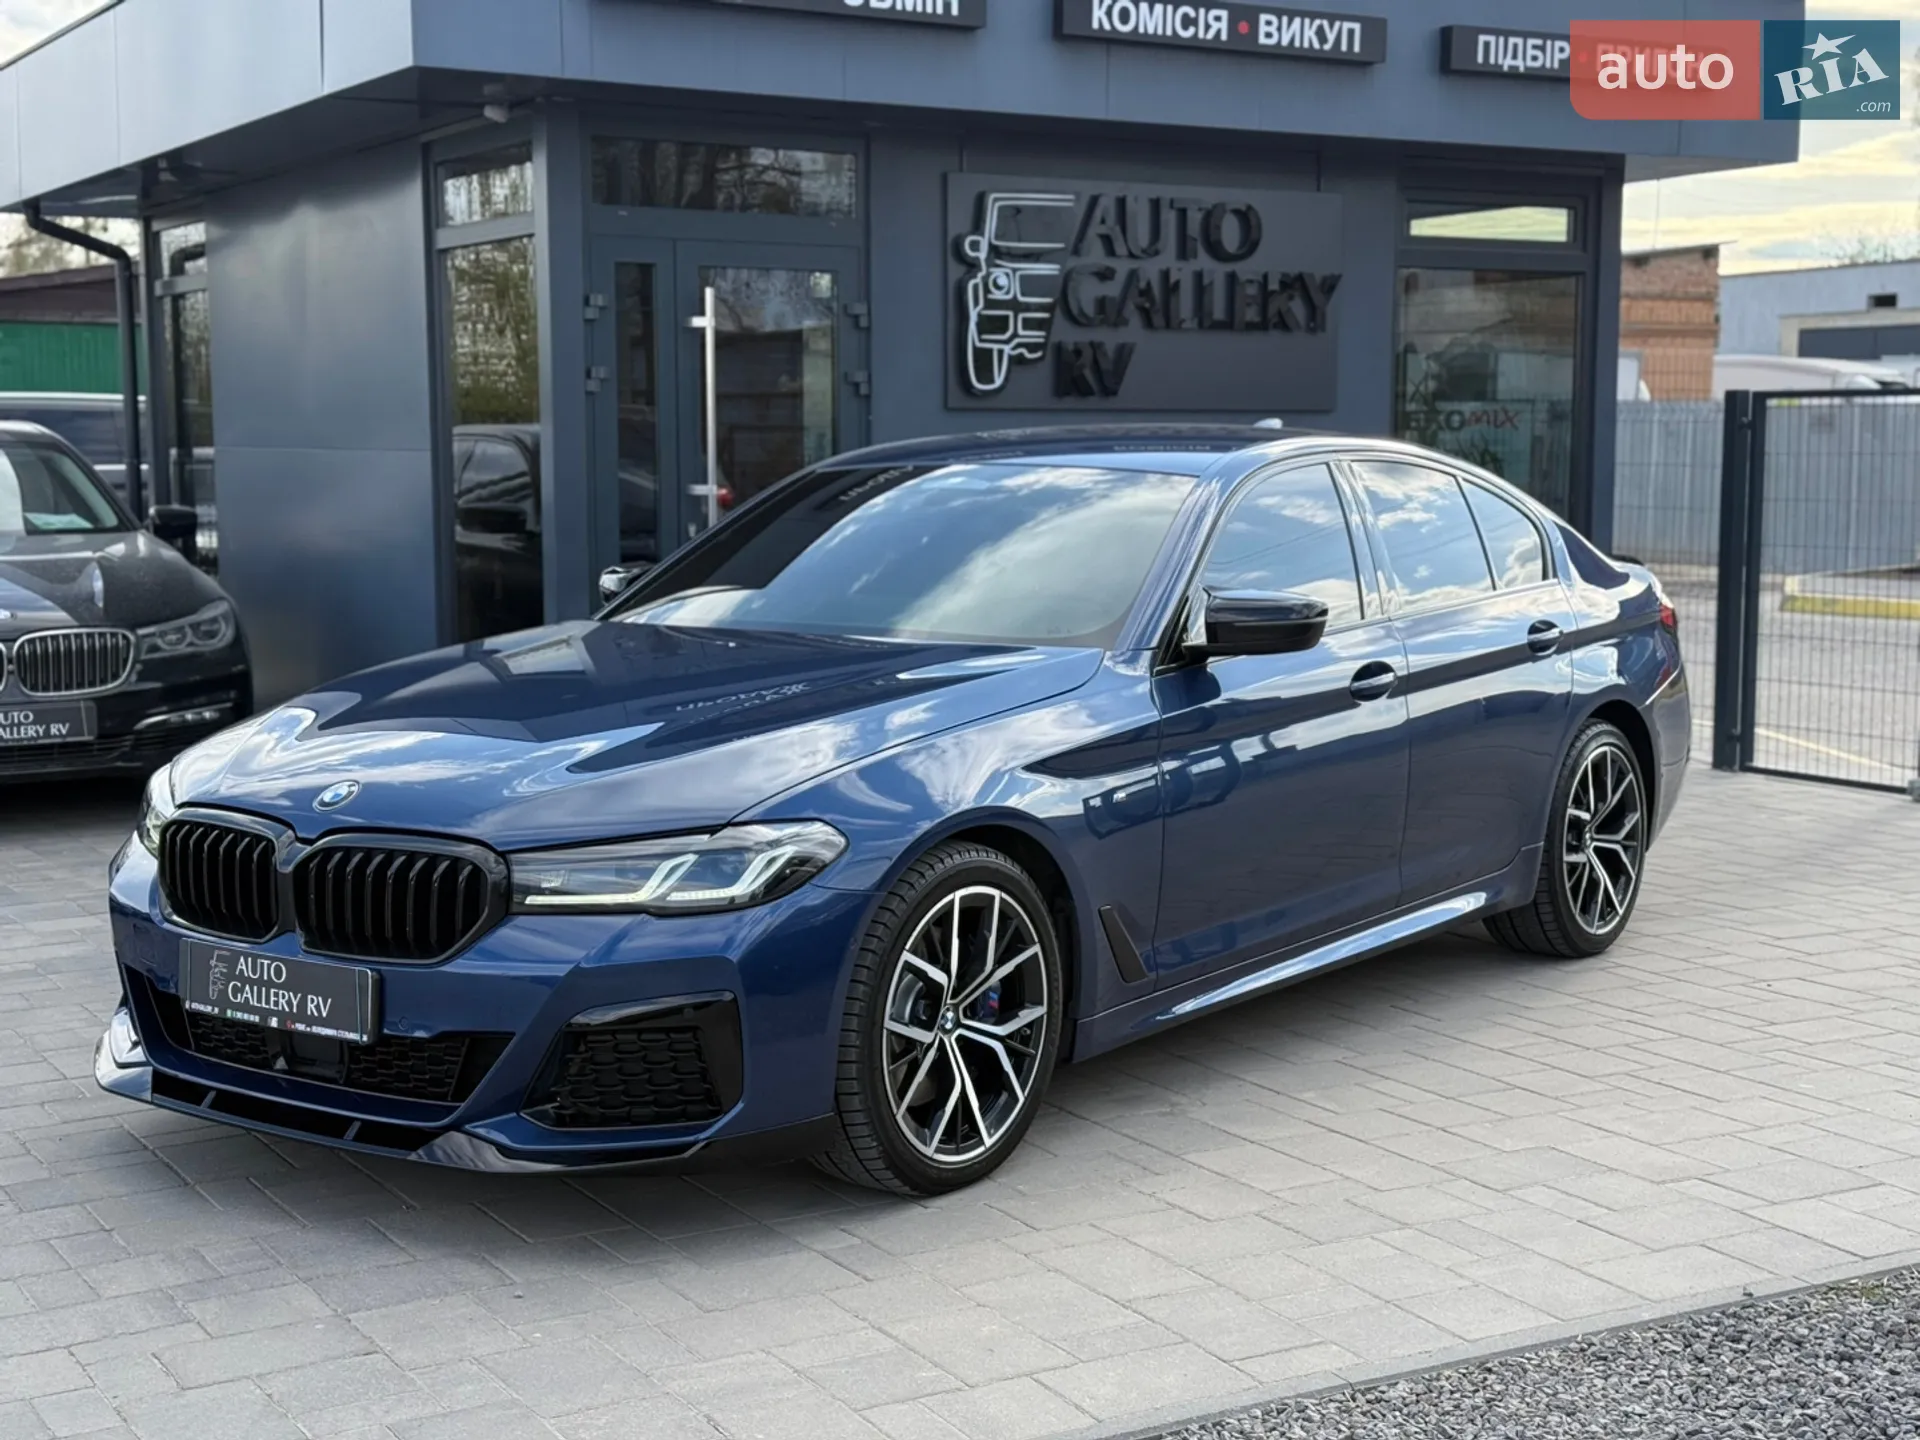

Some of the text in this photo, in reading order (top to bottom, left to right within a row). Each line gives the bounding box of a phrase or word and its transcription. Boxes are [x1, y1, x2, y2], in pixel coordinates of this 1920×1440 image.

[1091, 0, 1361, 53] КОМІСІЯ ВИКУП
[1477, 34, 1570, 73] ПІДБІР
[1072, 193, 1263, 263] AUTO
[1060, 263, 1343, 334] GALLERY
[0, 711, 34, 725] UTO
[50, 722, 70, 736] RV
[235, 955, 287, 983] AUTO
[227, 981, 302, 1014] GALLERY
[306, 994, 332, 1018] RV
